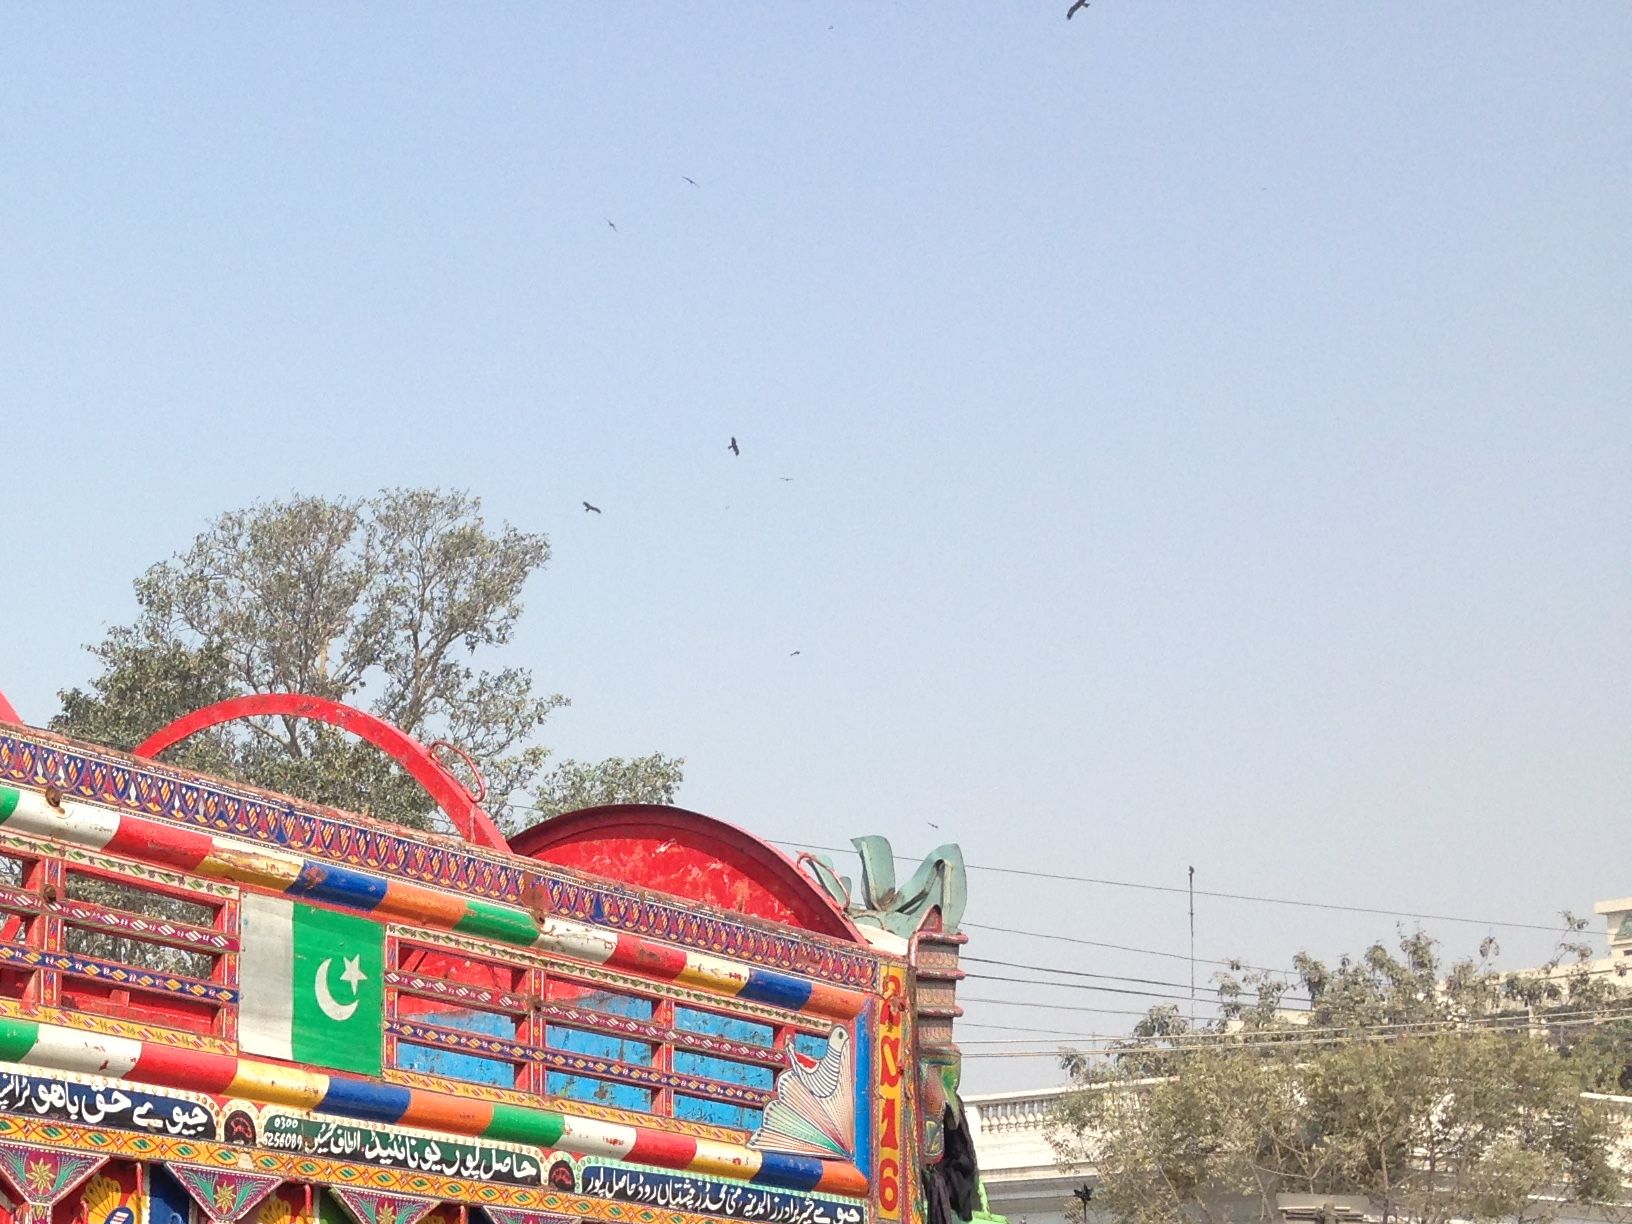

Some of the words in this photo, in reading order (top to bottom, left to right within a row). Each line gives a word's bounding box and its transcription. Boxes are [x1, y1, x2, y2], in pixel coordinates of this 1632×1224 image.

[81, 1084, 132, 1124] حق
[274, 1116, 299, 1129] 0300
[441, 1144, 481, 1180] پور
[480, 1149, 537, 1180] حاصل
[584, 1167, 606, 1198] پور
[605, 1170, 637, 1199] حاصل
[634, 1174, 657, 1202] روڈ
